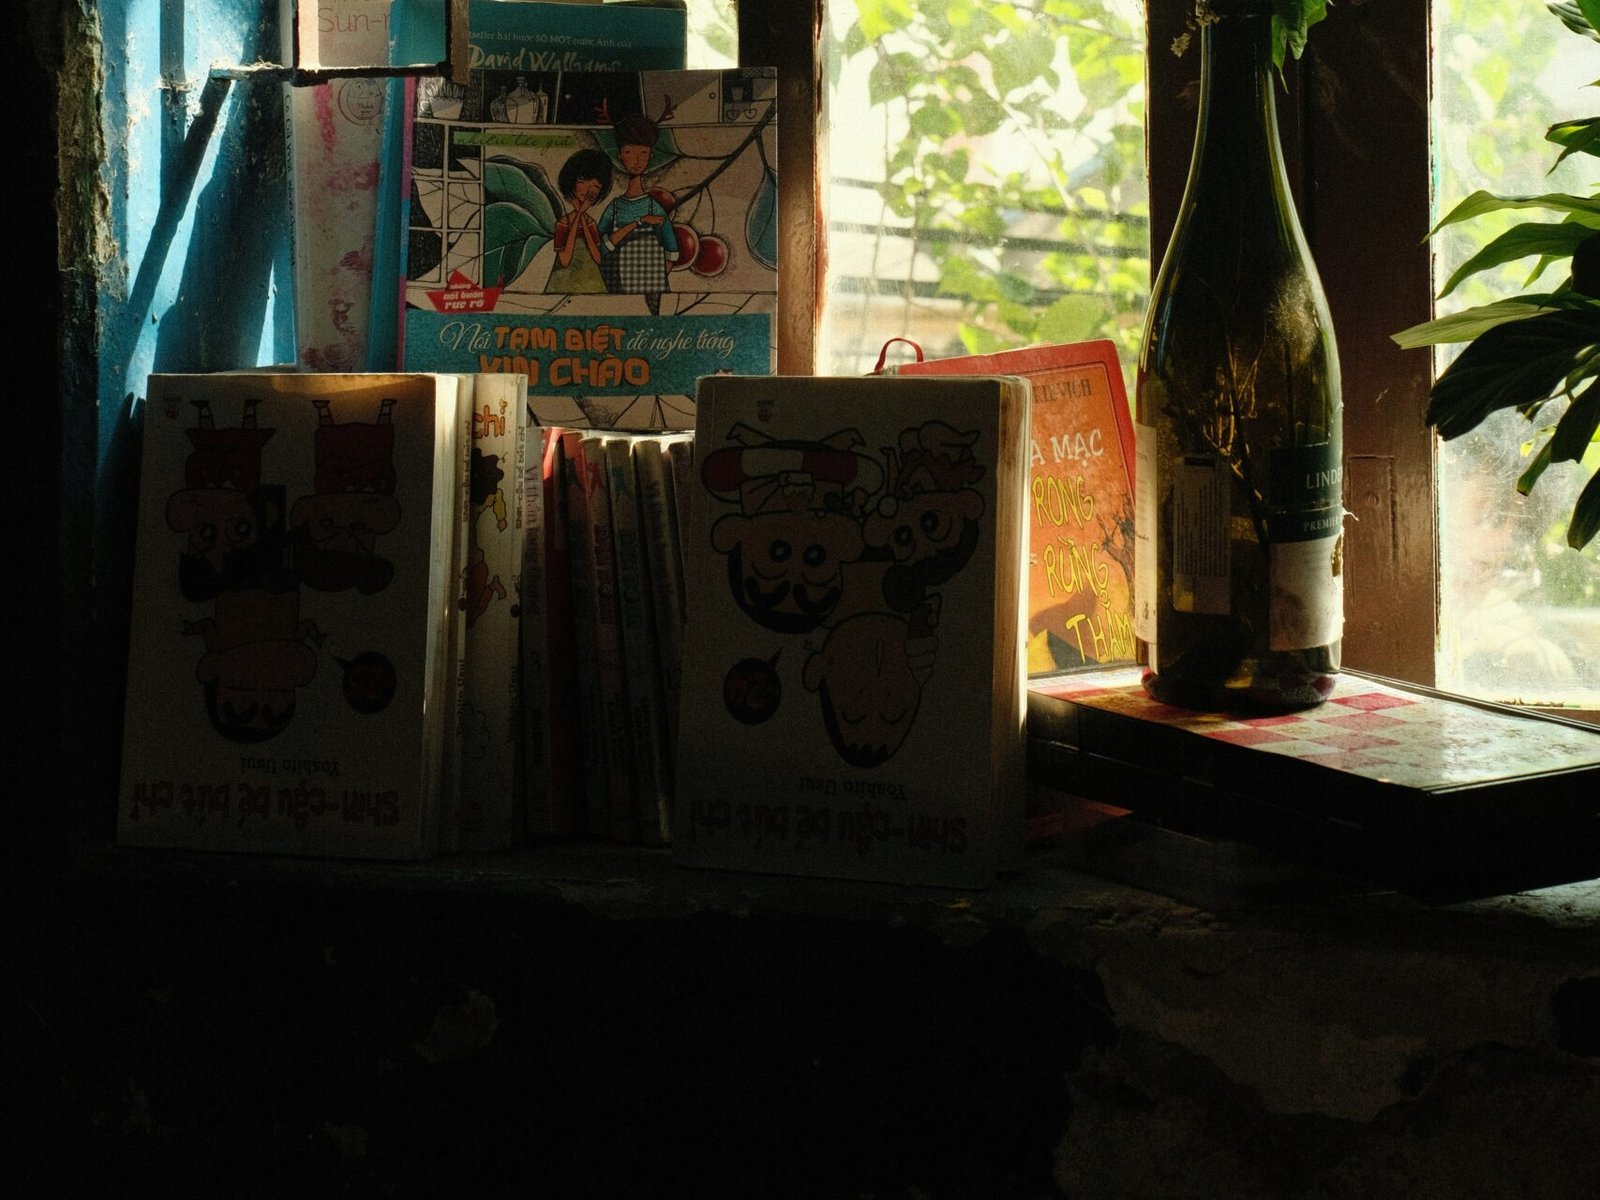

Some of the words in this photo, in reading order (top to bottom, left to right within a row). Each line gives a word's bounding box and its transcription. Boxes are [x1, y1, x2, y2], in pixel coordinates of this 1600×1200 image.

[469, 31, 495, 41] seller
[469, 43, 525, 69] David
[439, 321, 492, 353] Nói
[493, 325, 557, 355] TẠM
[564, 324, 627, 354] BIỆT
[627, 328, 654, 351] để
[651, 330, 692, 361] nghe
[695, 329, 737, 359] tiếng
[478, 354, 540, 388] XIN
[548, 354, 651, 388] CHÀO
[1031, 439, 1046, 467] A
[1050, 428, 1105, 467] MẠC
[1031, 474, 1095, 529] RONG
[1303, 514, 1342, 532] PREMIE
[1043, 535, 1110, 598] RỪNG
[1065, 589, 1136, 664] THẲM
[240, 757, 278, 774] Usui
[799, 778, 837, 797] Usui
